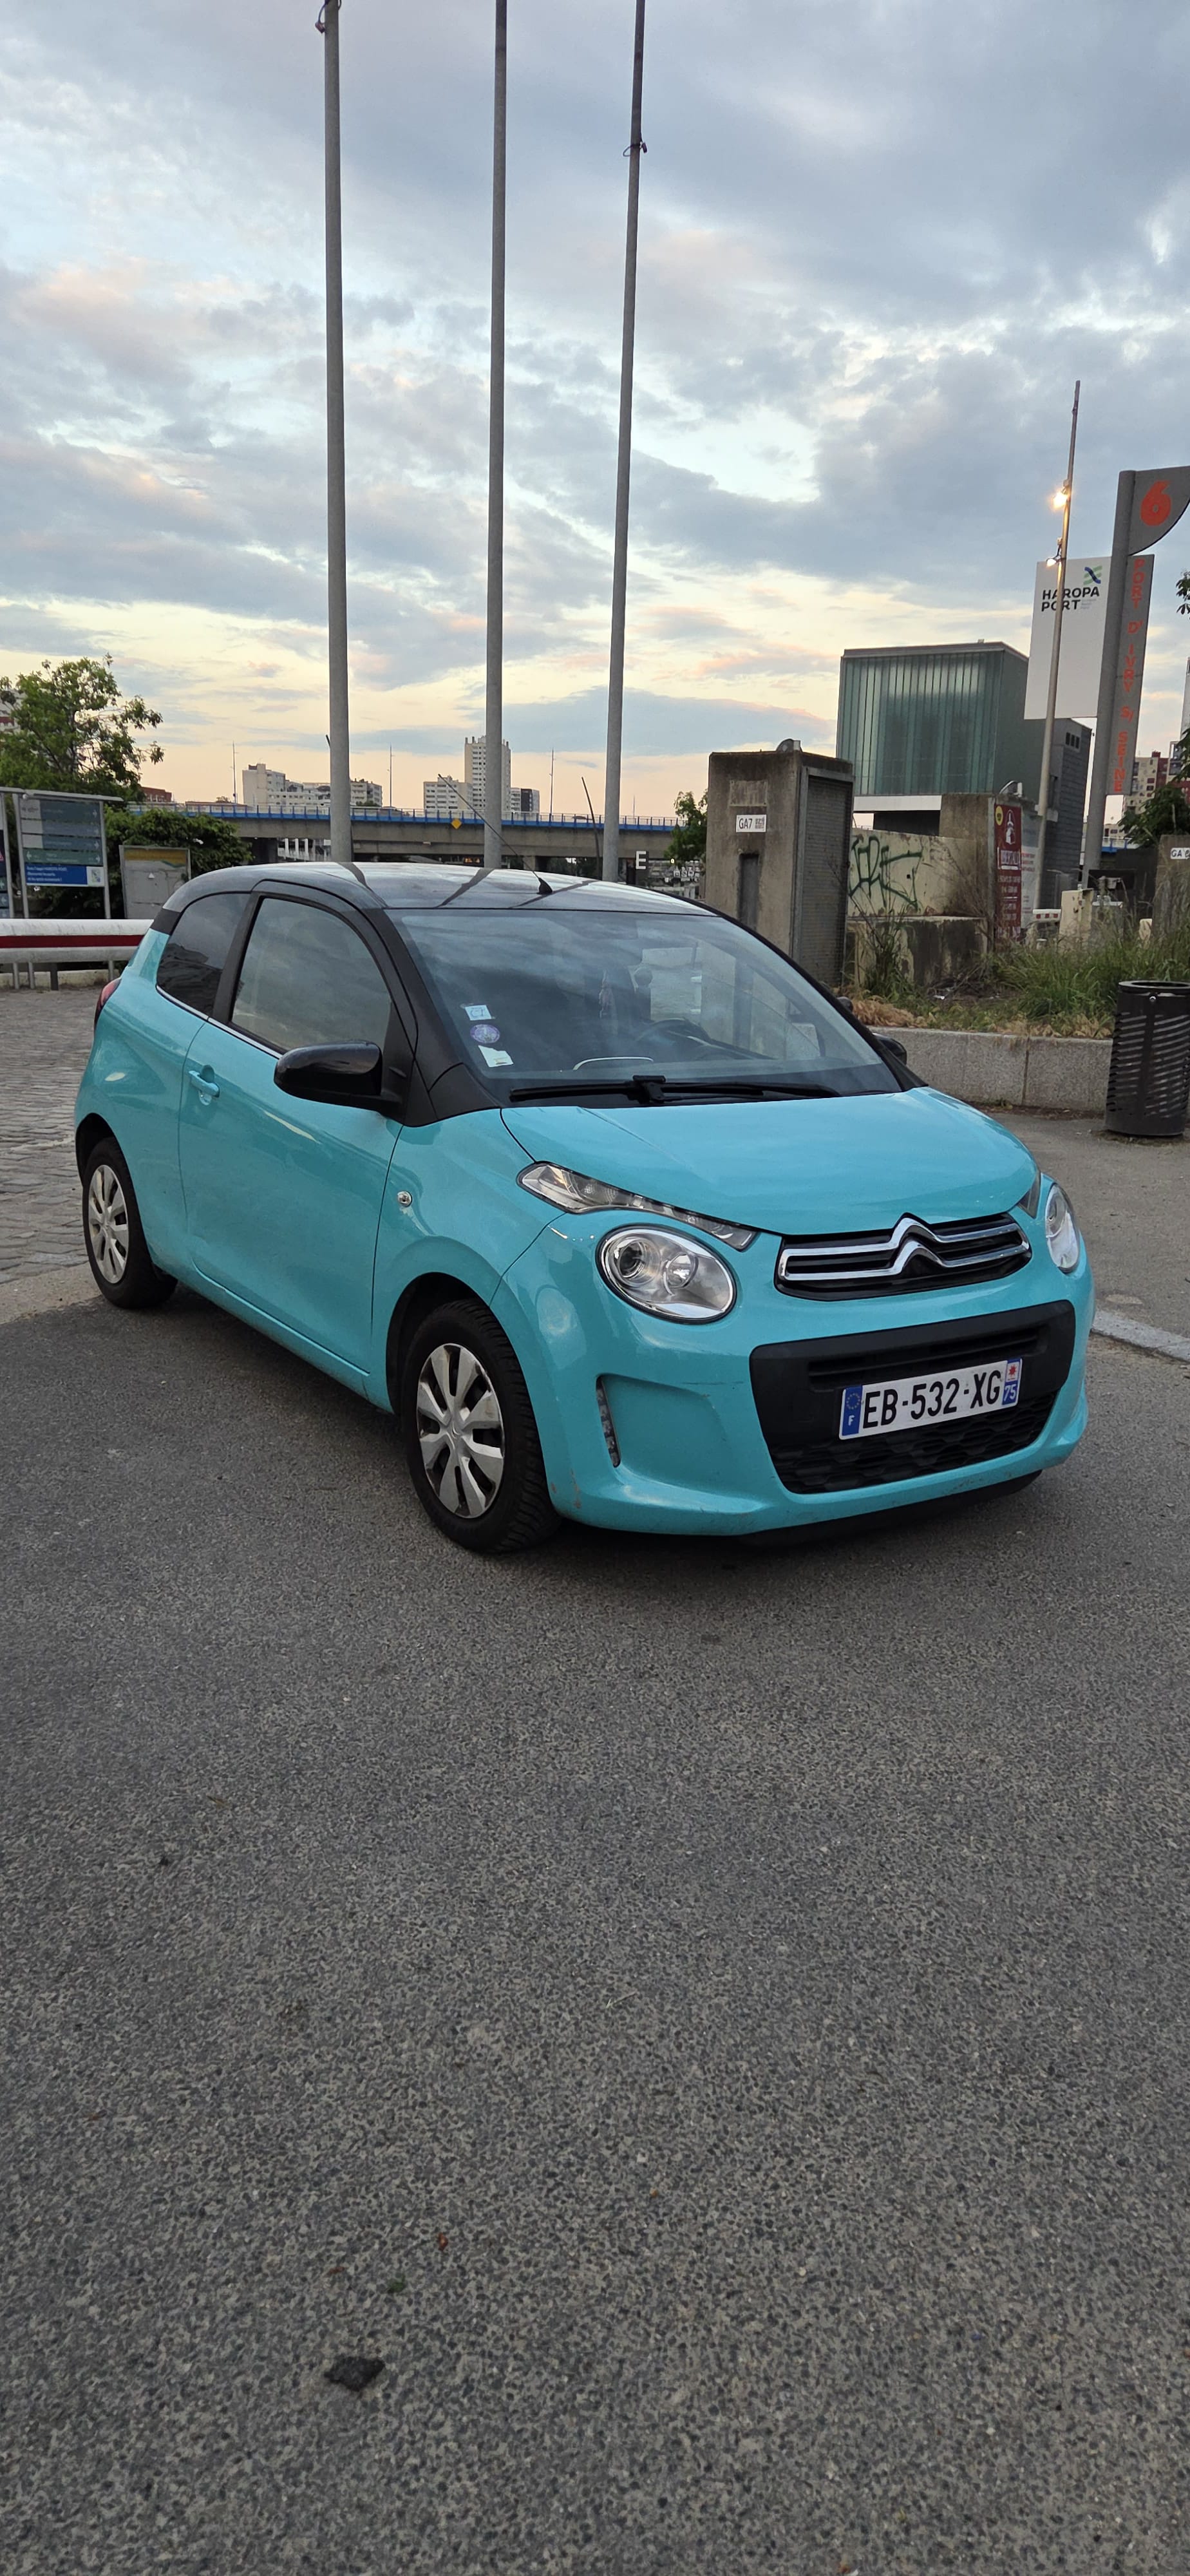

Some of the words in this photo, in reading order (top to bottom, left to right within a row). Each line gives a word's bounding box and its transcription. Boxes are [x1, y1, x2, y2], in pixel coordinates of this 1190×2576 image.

[1140, 480, 1171, 527] 6
[1131, 559, 1146, 609] PORT
[1113, 731, 1128, 793] SEINE
[739, 818, 753, 829] GA7
[636, 851, 647, 869] E
[847, 1415, 855, 1426] F
[862, 1370, 1001, 1429] EB-532-XG
[1003, 1384, 1017, 1402] 75
